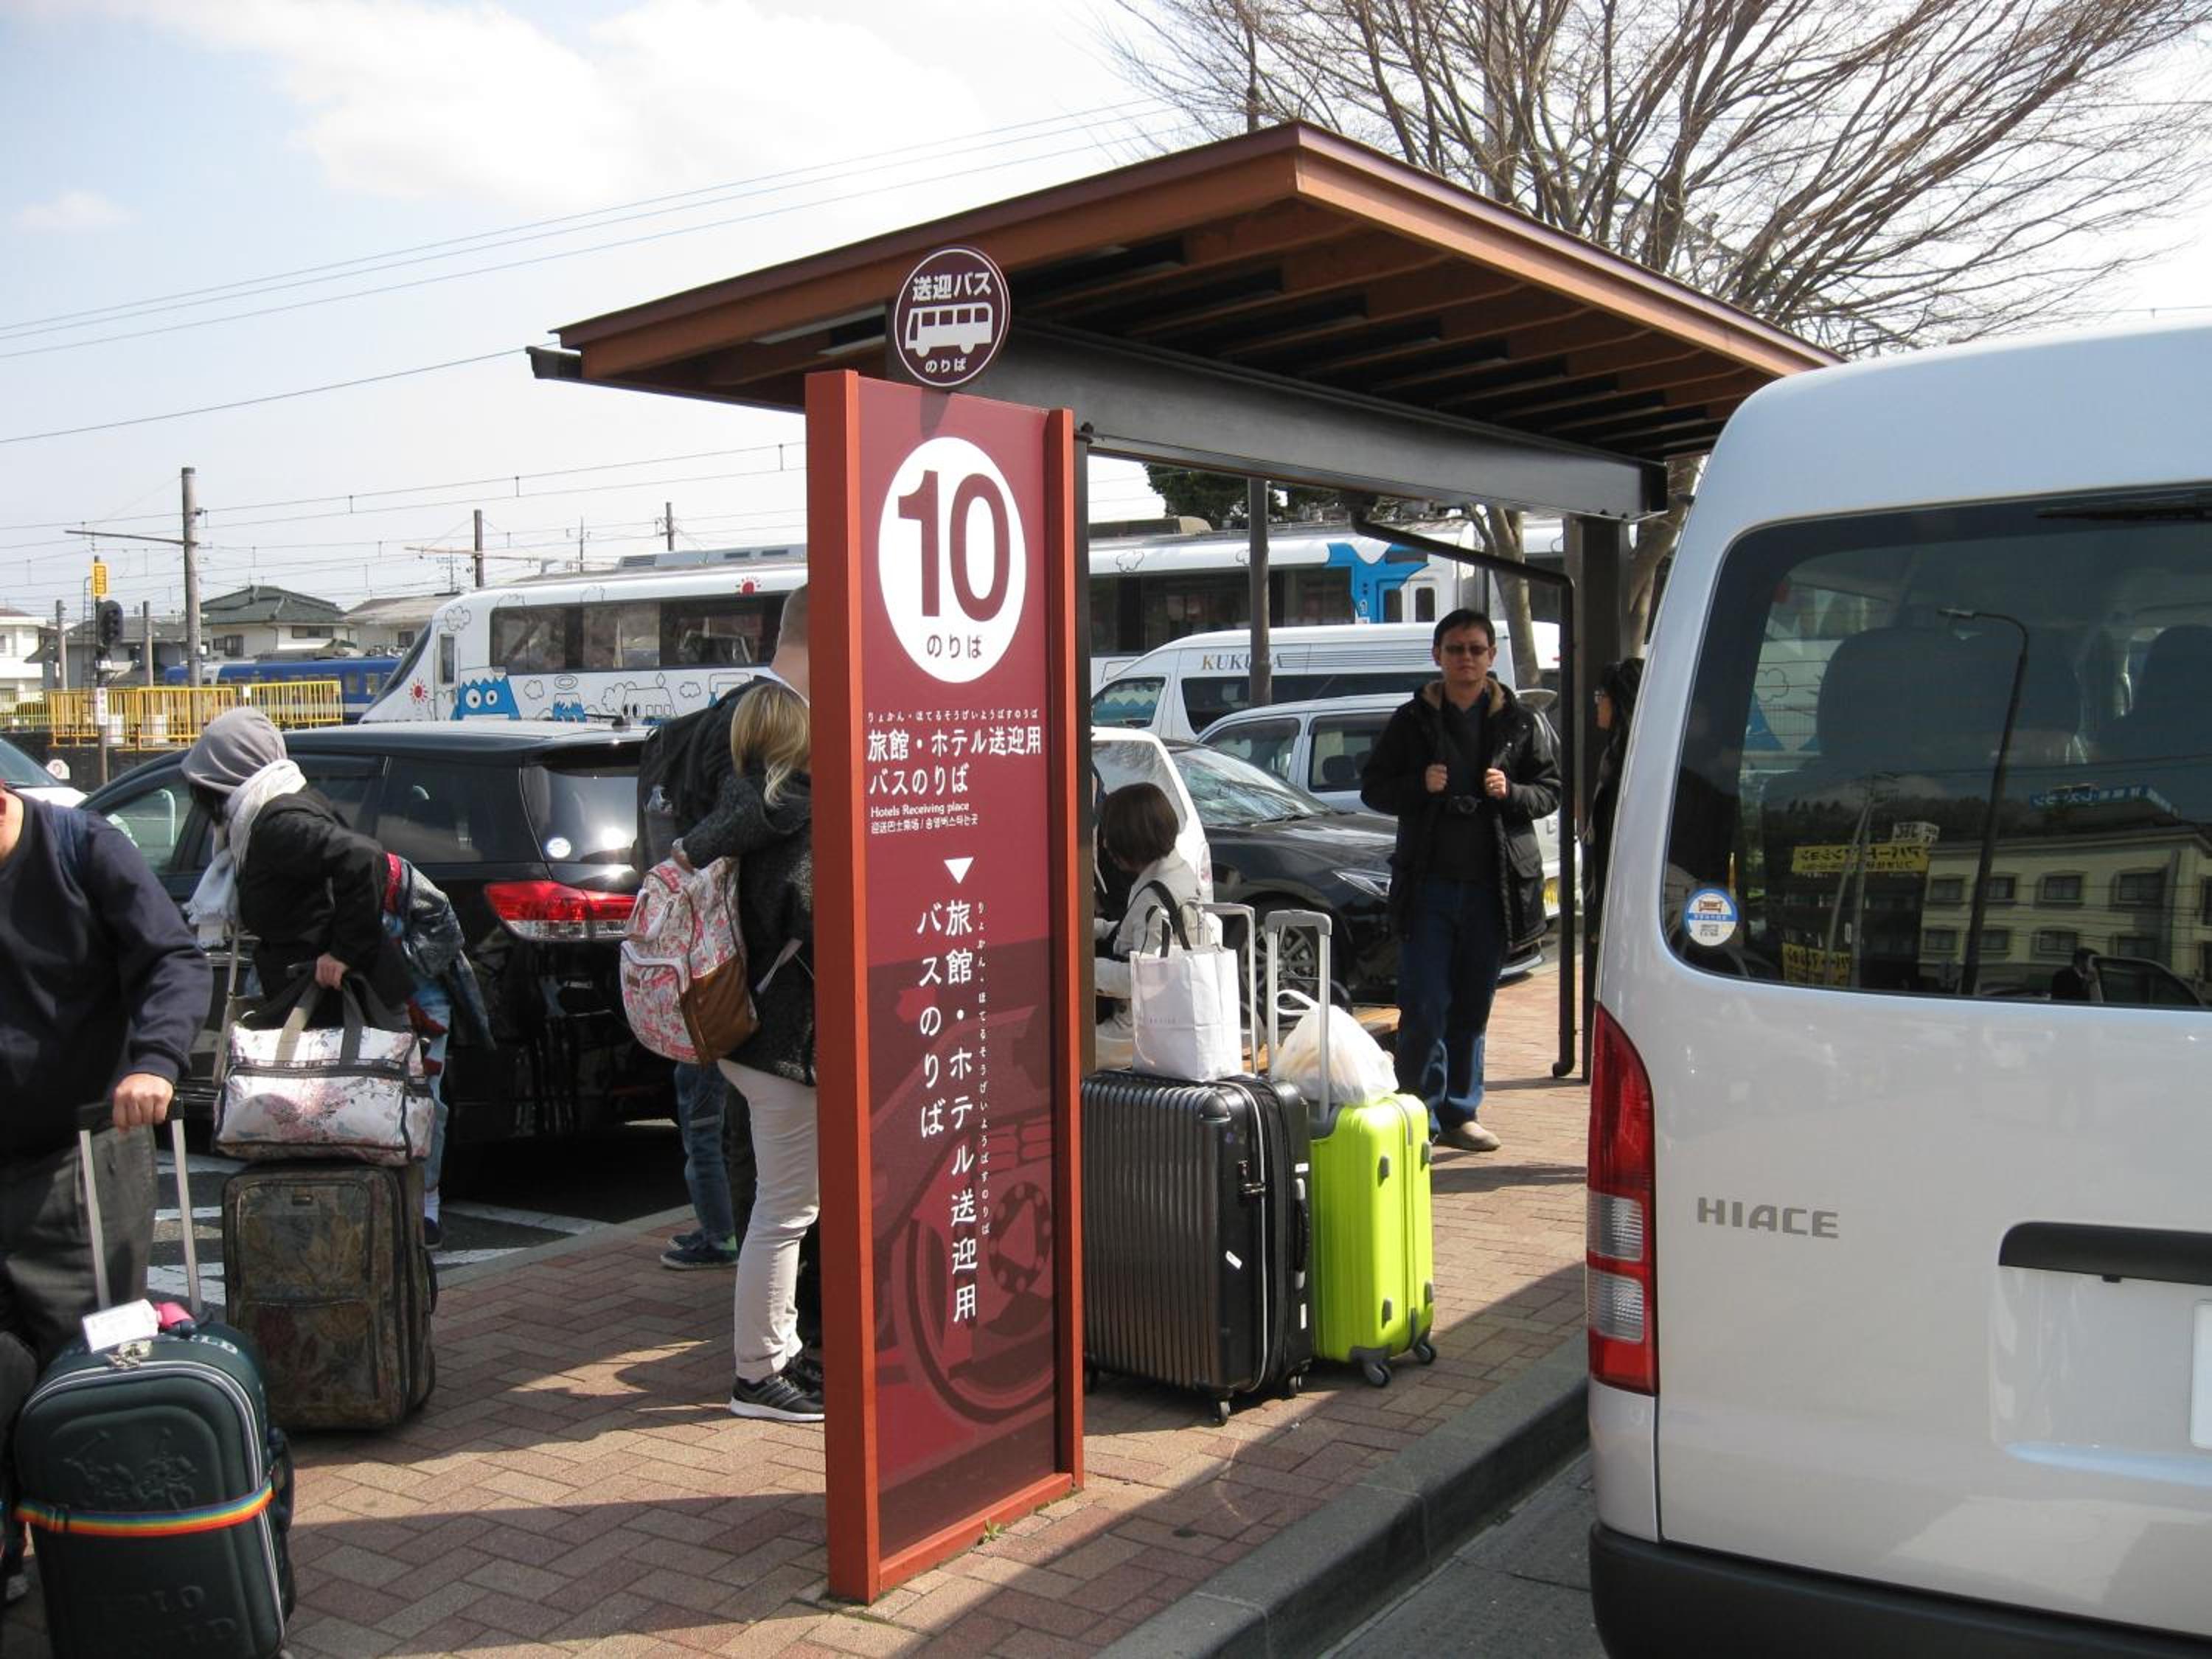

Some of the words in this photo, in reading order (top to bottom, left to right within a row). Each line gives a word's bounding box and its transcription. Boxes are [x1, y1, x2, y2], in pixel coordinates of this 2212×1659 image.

[913, 271, 992, 302] 送迎バス
[925, 358, 967, 373] のりば
[898, 470, 1010, 622] 10
[868, 726, 1041, 762] 旅館・ホテル送迎用
[869, 762, 970, 796] バスのりば
[871, 805, 900, 818] Hotels
[902, 803, 944, 815] Receiving
[947, 800, 970, 814] place
[917, 901, 946, 1139] バスのりば
[945, 900, 978, 1322] 旅館・ホテル送迎用
[1697, 1197, 1839, 1239] HIACE
